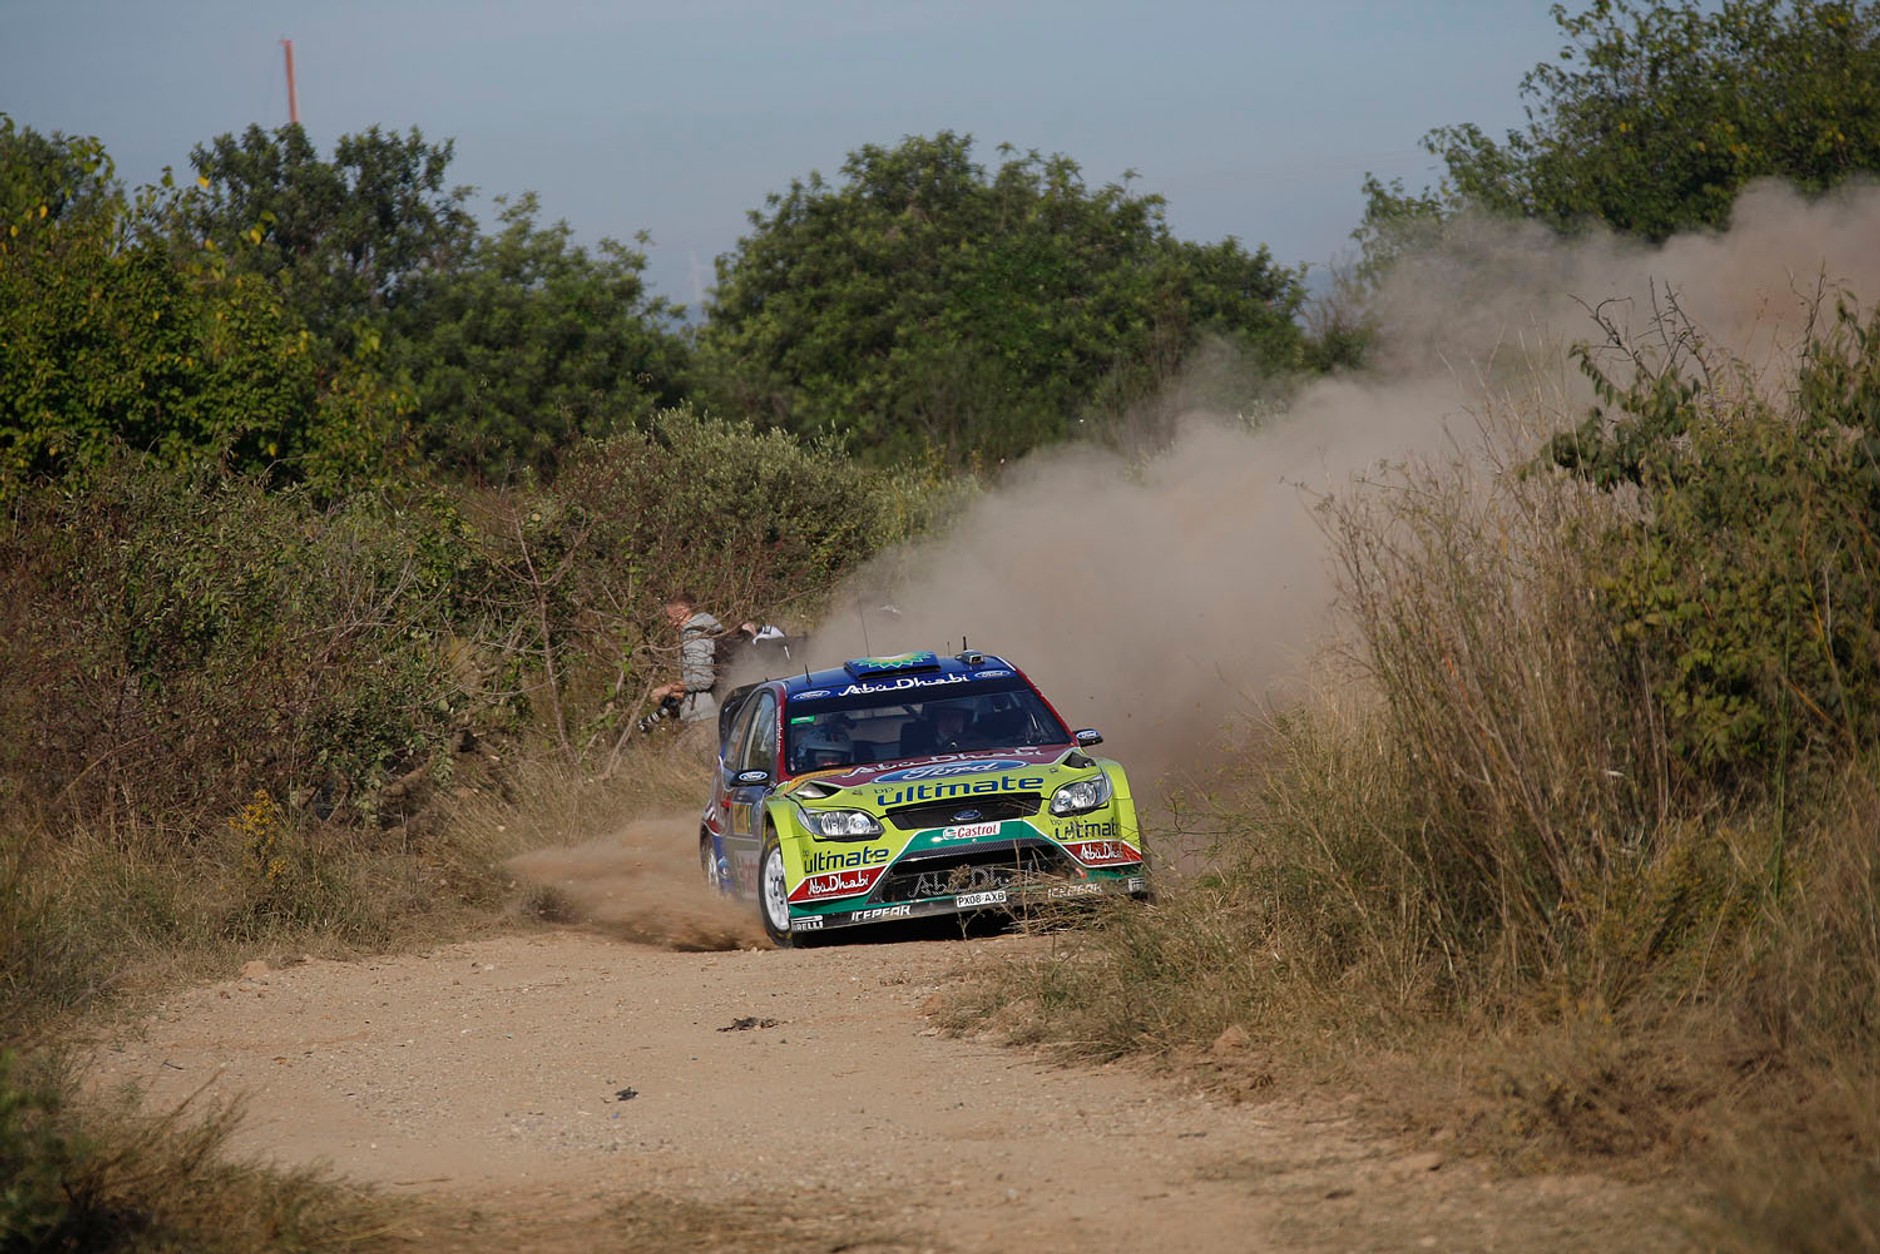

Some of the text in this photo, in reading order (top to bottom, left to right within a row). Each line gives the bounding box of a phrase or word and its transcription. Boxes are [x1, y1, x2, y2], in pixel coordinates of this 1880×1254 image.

[902, 760, 999, 779] Ford
[877, 775, 1045, 807] ultimate
[957, 823, 997, 838] Castrol
[1055, 816, 1118, 840] ultimat
[804, 846, 890, 874] ultimate
[828, 870, 870, 892] Dhabi
[958, 893, 1005, 906] PX08 AXB
